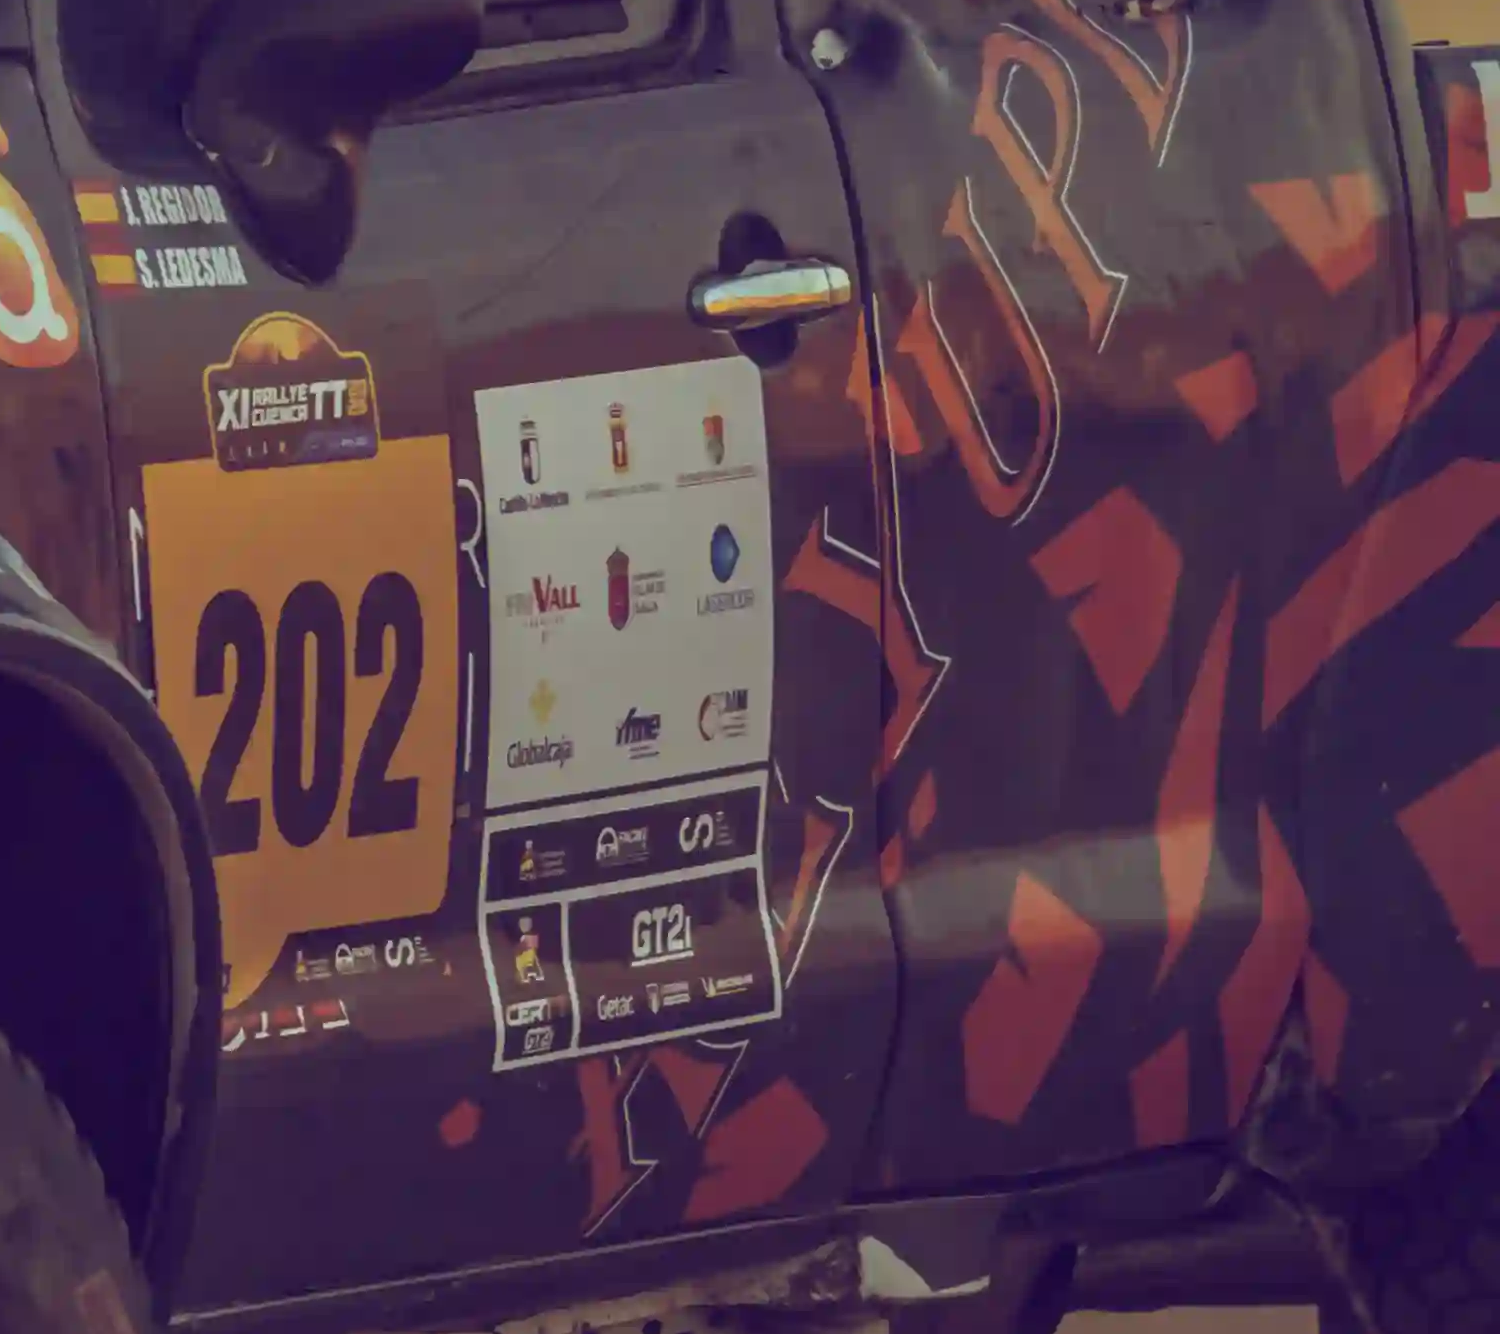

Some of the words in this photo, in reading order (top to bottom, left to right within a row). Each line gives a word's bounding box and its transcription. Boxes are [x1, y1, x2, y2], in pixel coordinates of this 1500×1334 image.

[139, 183, 228, 225] REGIDOR
[157, 246, 248, 288] LEDESMA
[252, 383, 308, 406] RALLYE
[309, 379, 348, 420] TT
[252, 404, 308, 426] CUENCA
[195, 570, 424, 858] 202
